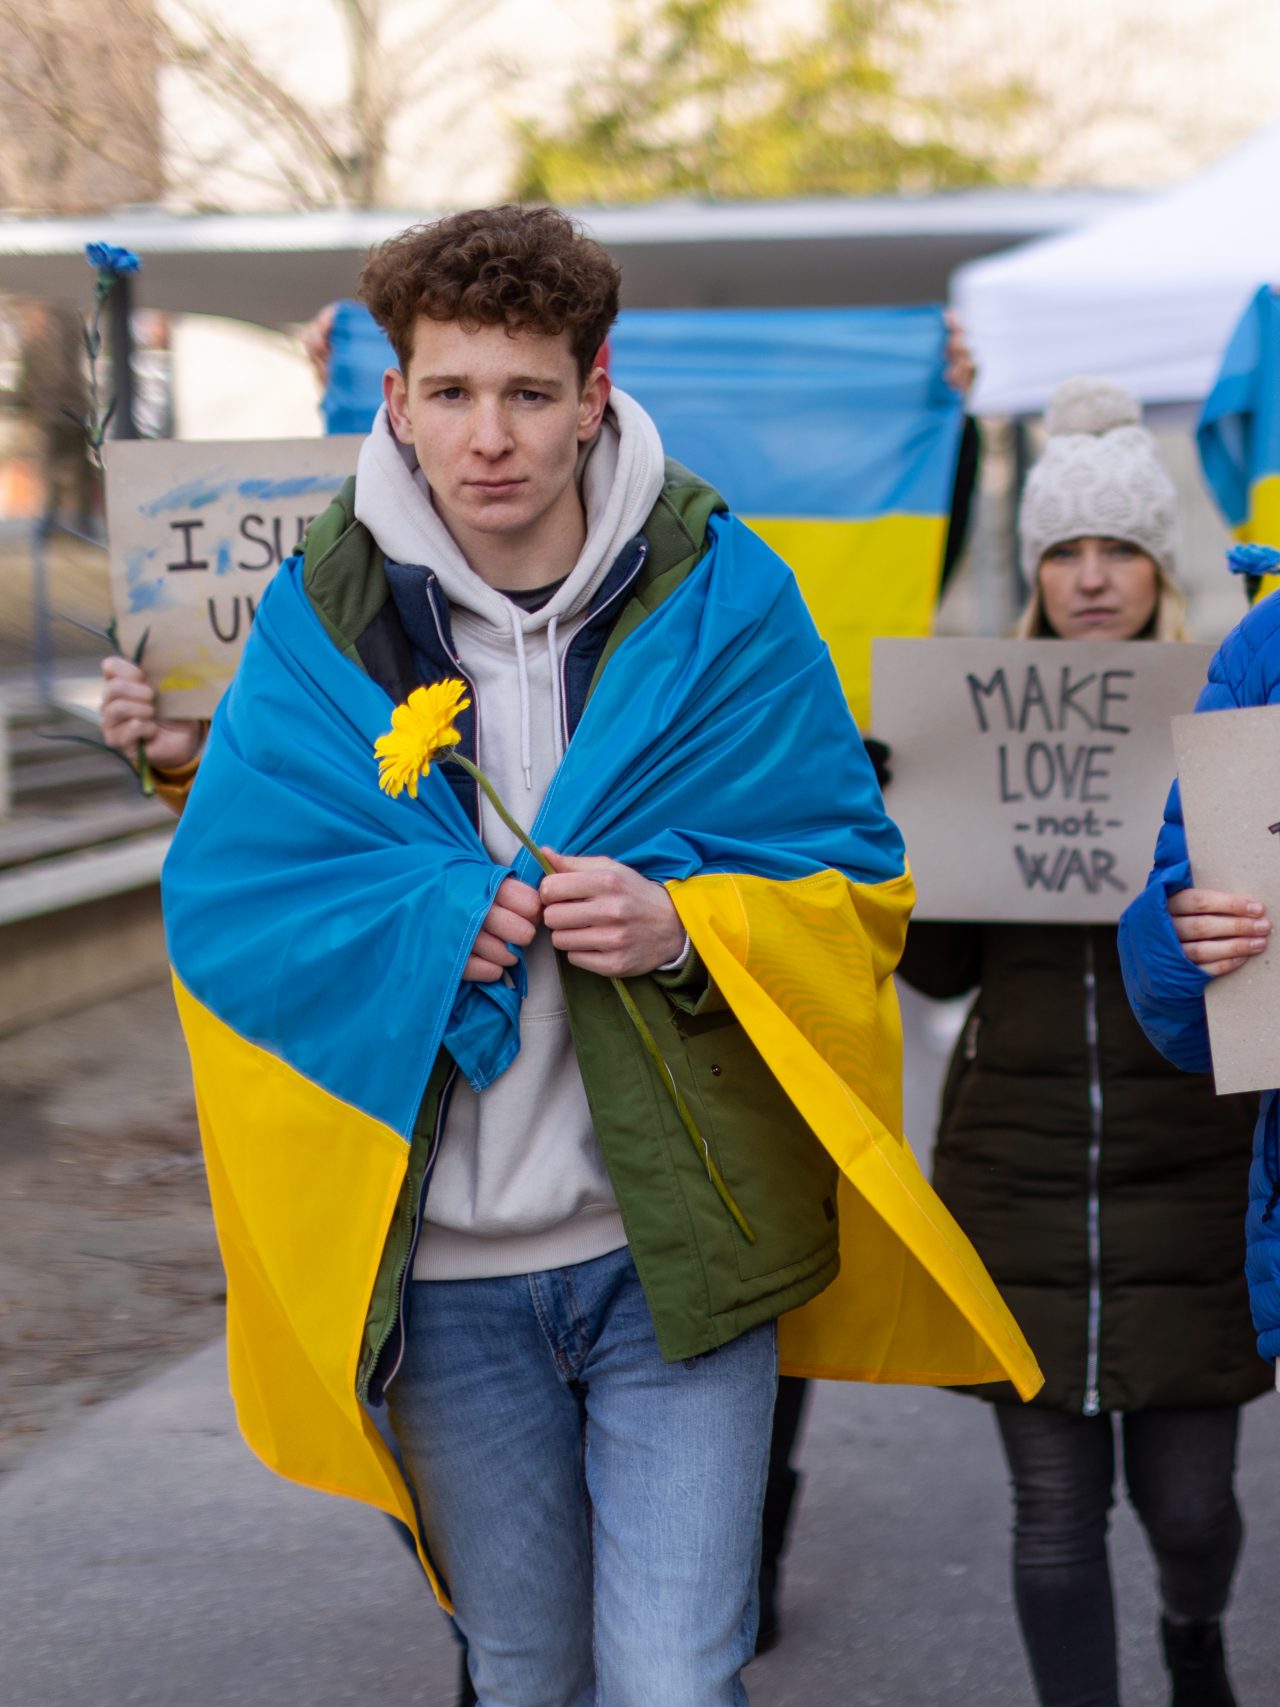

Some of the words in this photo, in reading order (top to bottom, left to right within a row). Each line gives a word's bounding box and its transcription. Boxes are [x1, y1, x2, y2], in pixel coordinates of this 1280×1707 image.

[167, 519, 208, 572] I
[237, 513, 317, 571] SU
[966, 664, 1135, 734] MAKE
[998, 741, 1116, 803] LOVE
[1013, 844, 1128, 894] WAR
